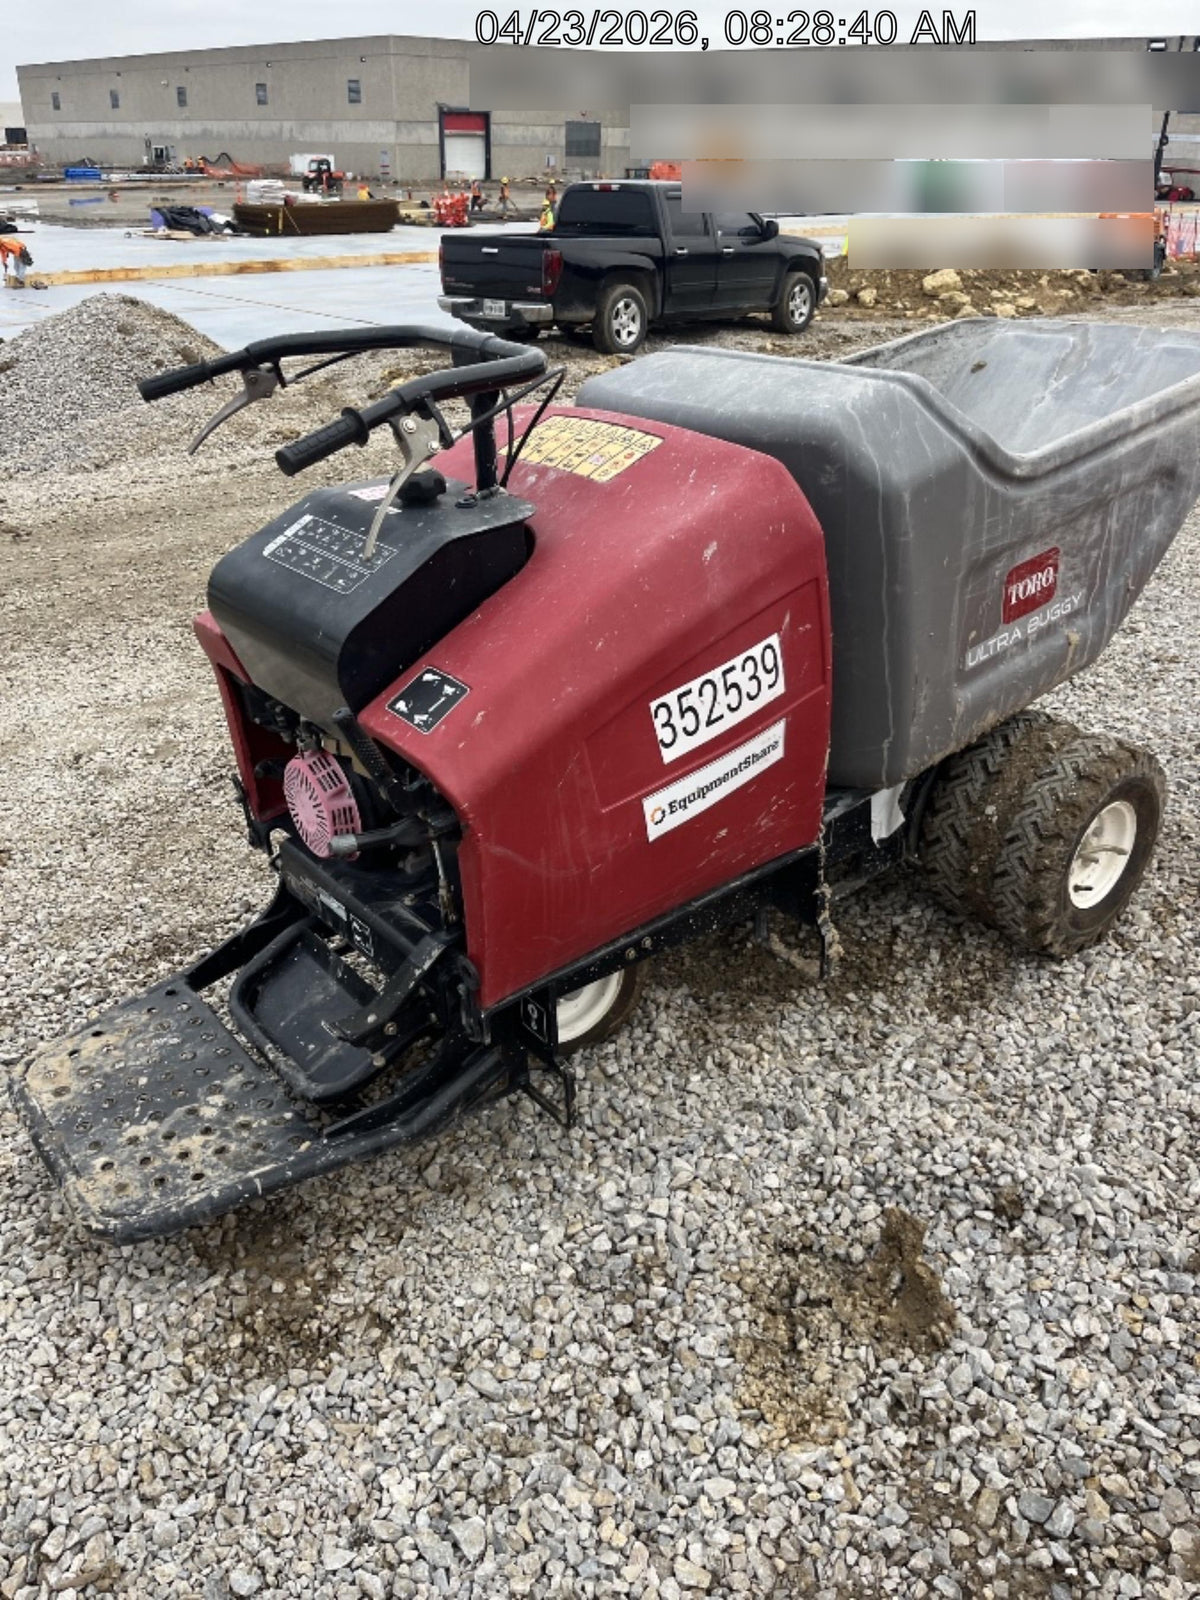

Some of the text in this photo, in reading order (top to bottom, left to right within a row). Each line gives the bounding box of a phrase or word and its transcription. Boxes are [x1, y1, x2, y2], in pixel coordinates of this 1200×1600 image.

[1007, 567, 1055, 606] TORO
[968, 592, 1082, 668] ULTRA BUGGY
[653, 643, 780, 750] 352539
[667, 739, 780, 816] EquipmentShare
